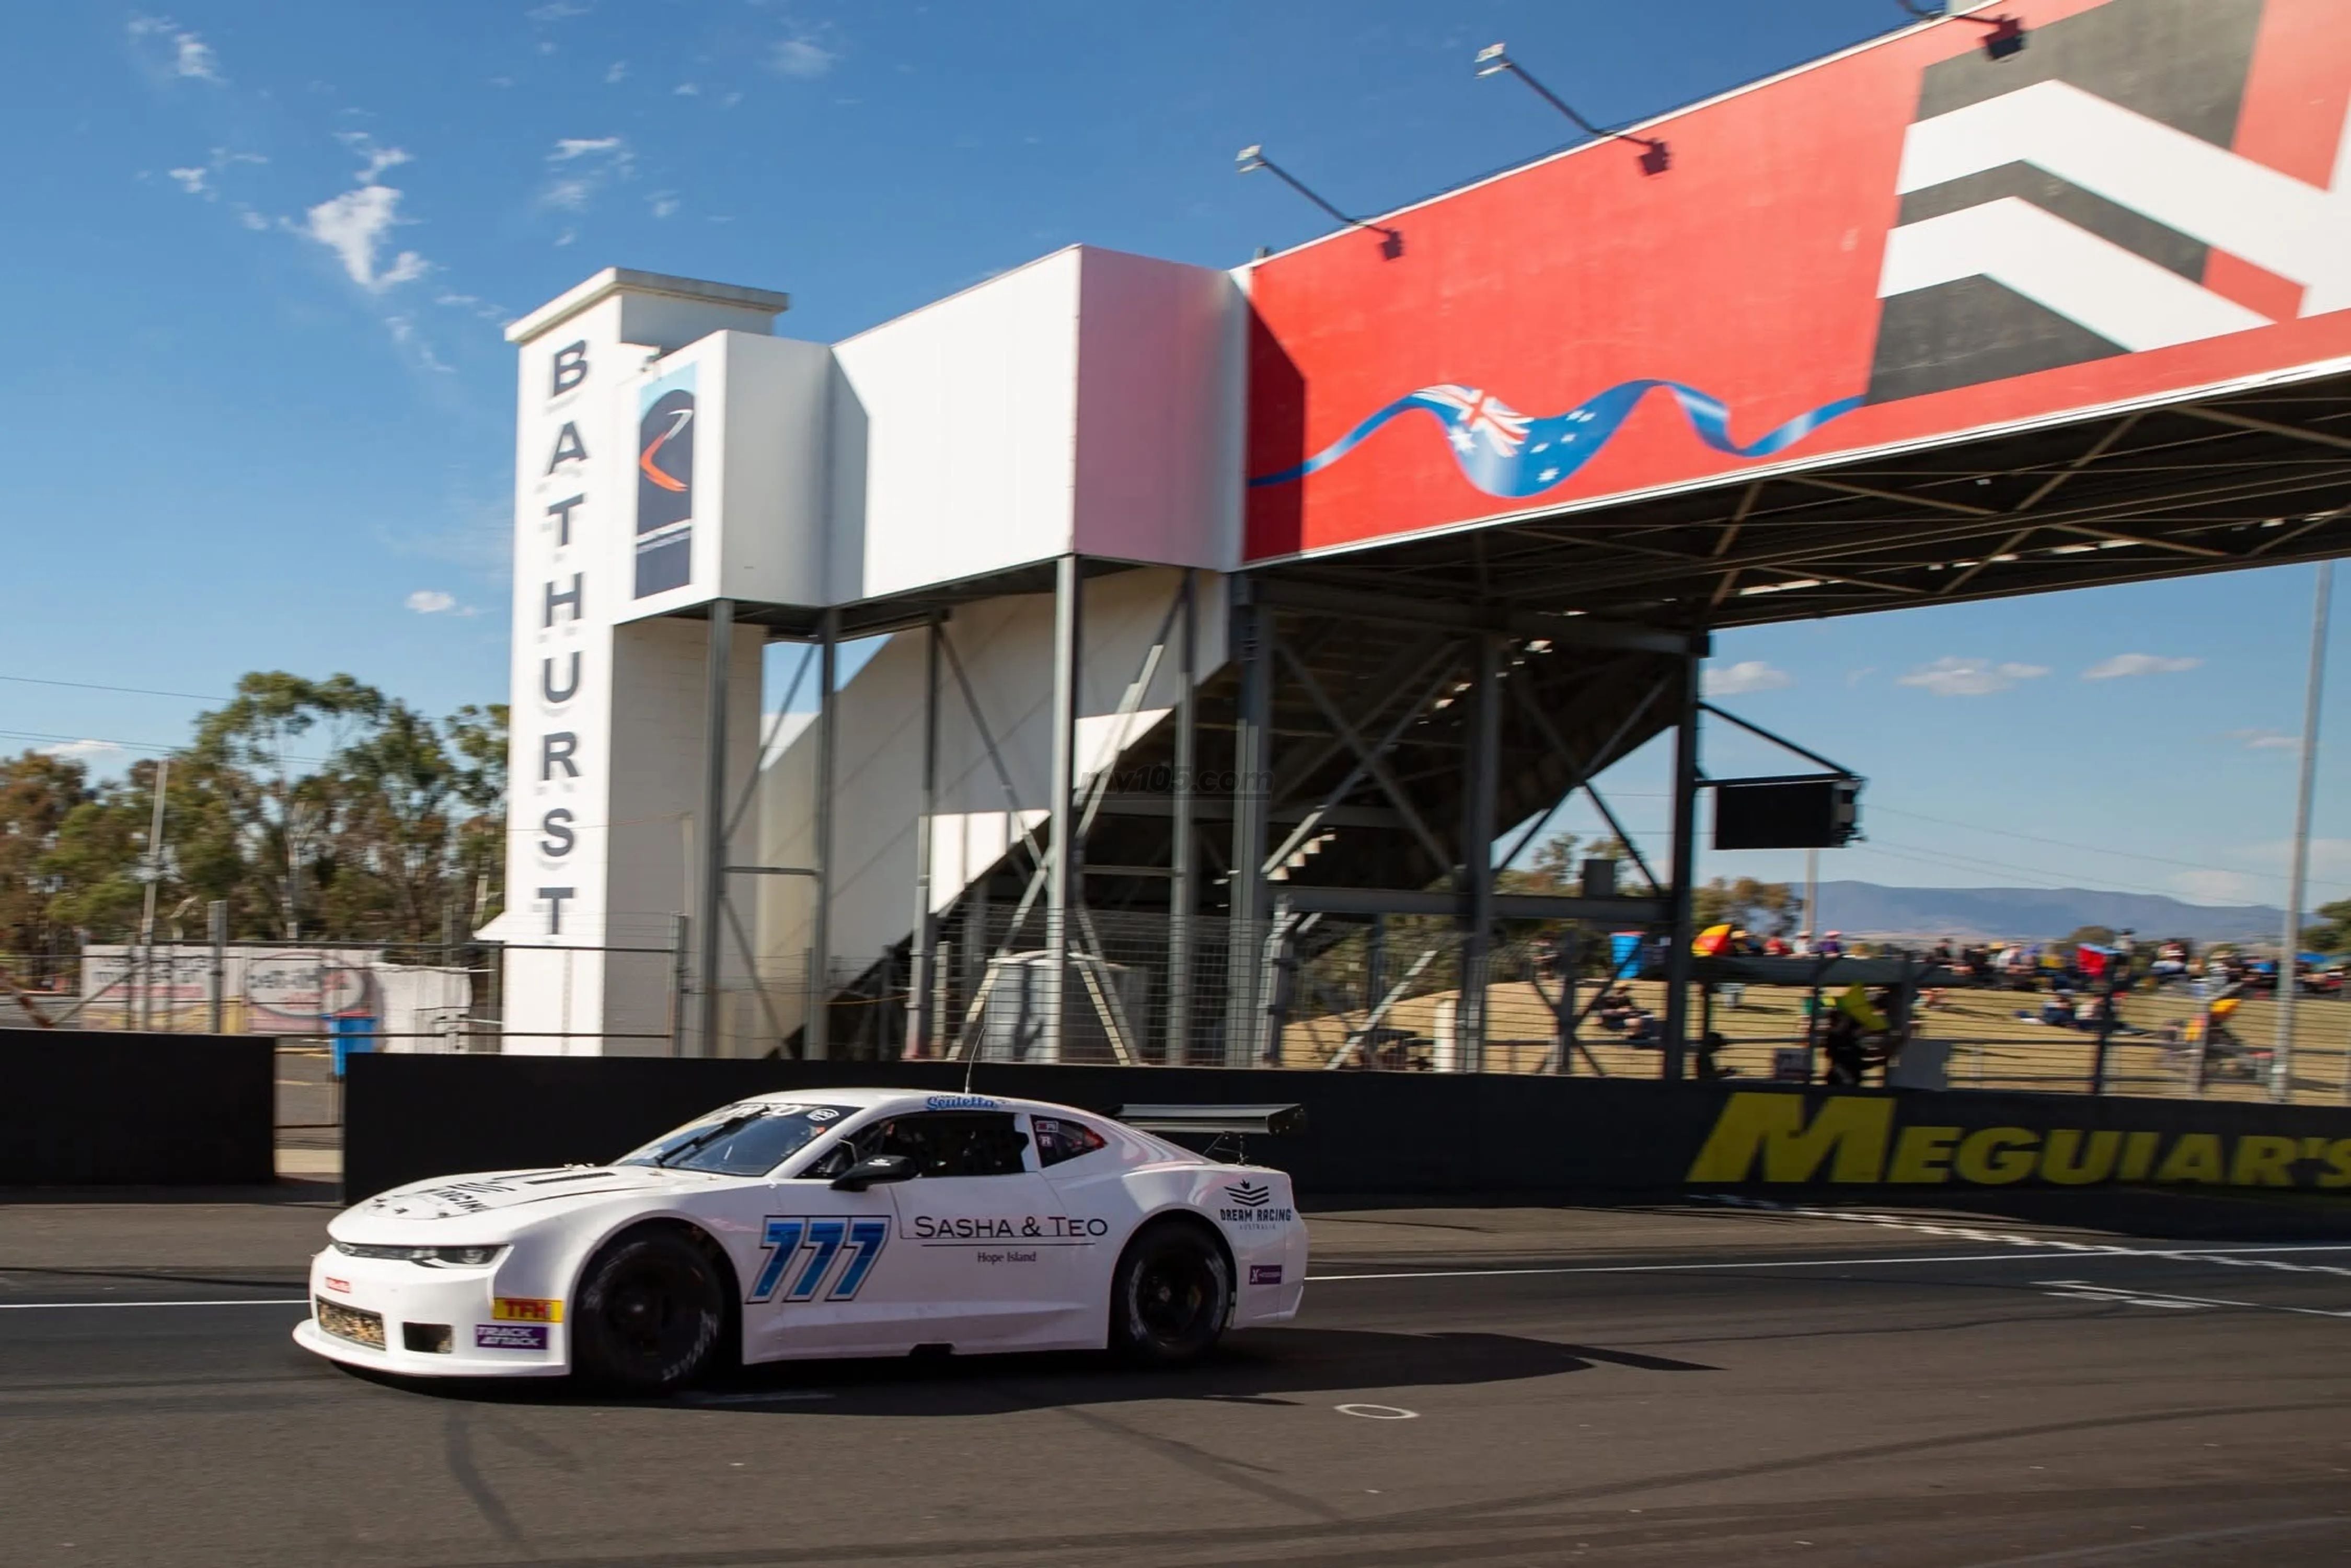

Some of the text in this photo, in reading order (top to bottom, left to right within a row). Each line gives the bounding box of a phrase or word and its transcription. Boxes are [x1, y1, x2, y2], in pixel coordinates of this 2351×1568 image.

[538, 339, 588, 936] BATHURST
[1686, 1092, 2351, 1188] MEGUIAR'S
[915, 1216, 1108, 1238] SASHA & TEO
[1220, 1209, 1291, 1221] DREAM RACING
[745, 1215, 891, 1304] 777
[977, 1251, 1036, 1263] Hope Island
